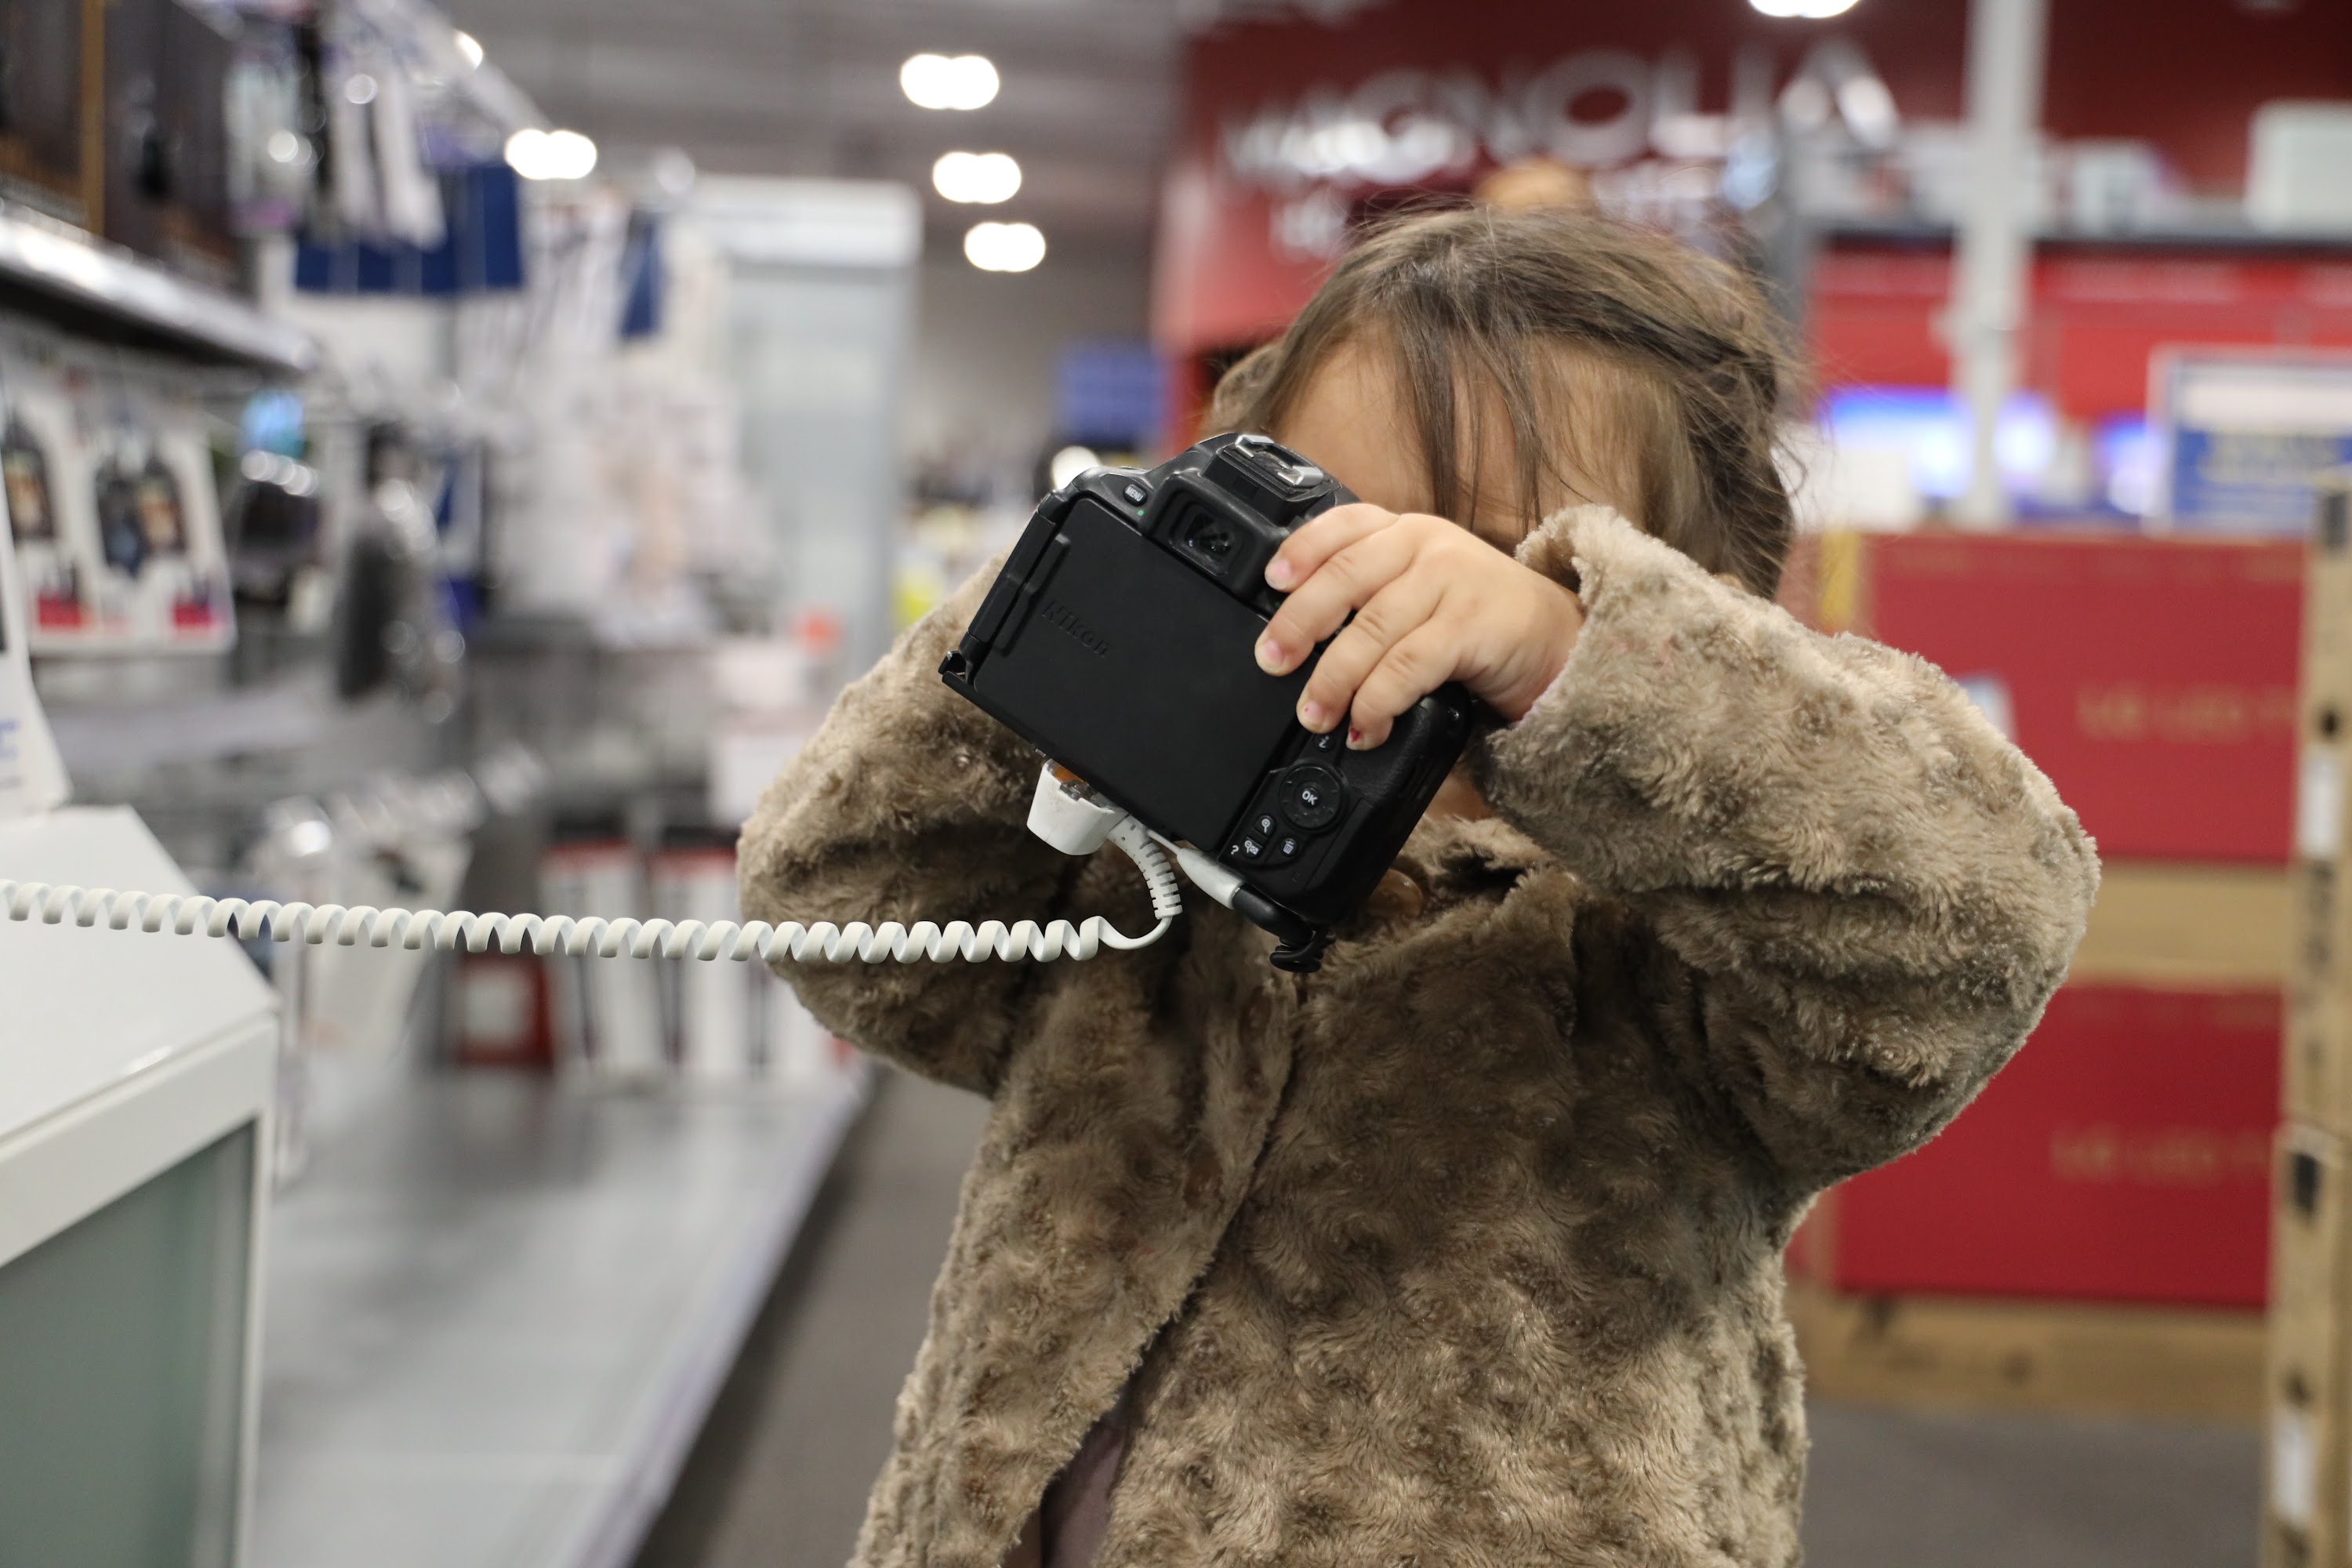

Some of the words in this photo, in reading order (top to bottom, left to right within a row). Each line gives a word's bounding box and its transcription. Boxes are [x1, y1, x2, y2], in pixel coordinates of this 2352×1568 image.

[1225, 42, 1896, 185] MAGNOLIA
[1124, 486, 1144, 502] MENU
[1041, 599, 1111, 659] Nikon
[1301, 790, 1318, 805] OK
